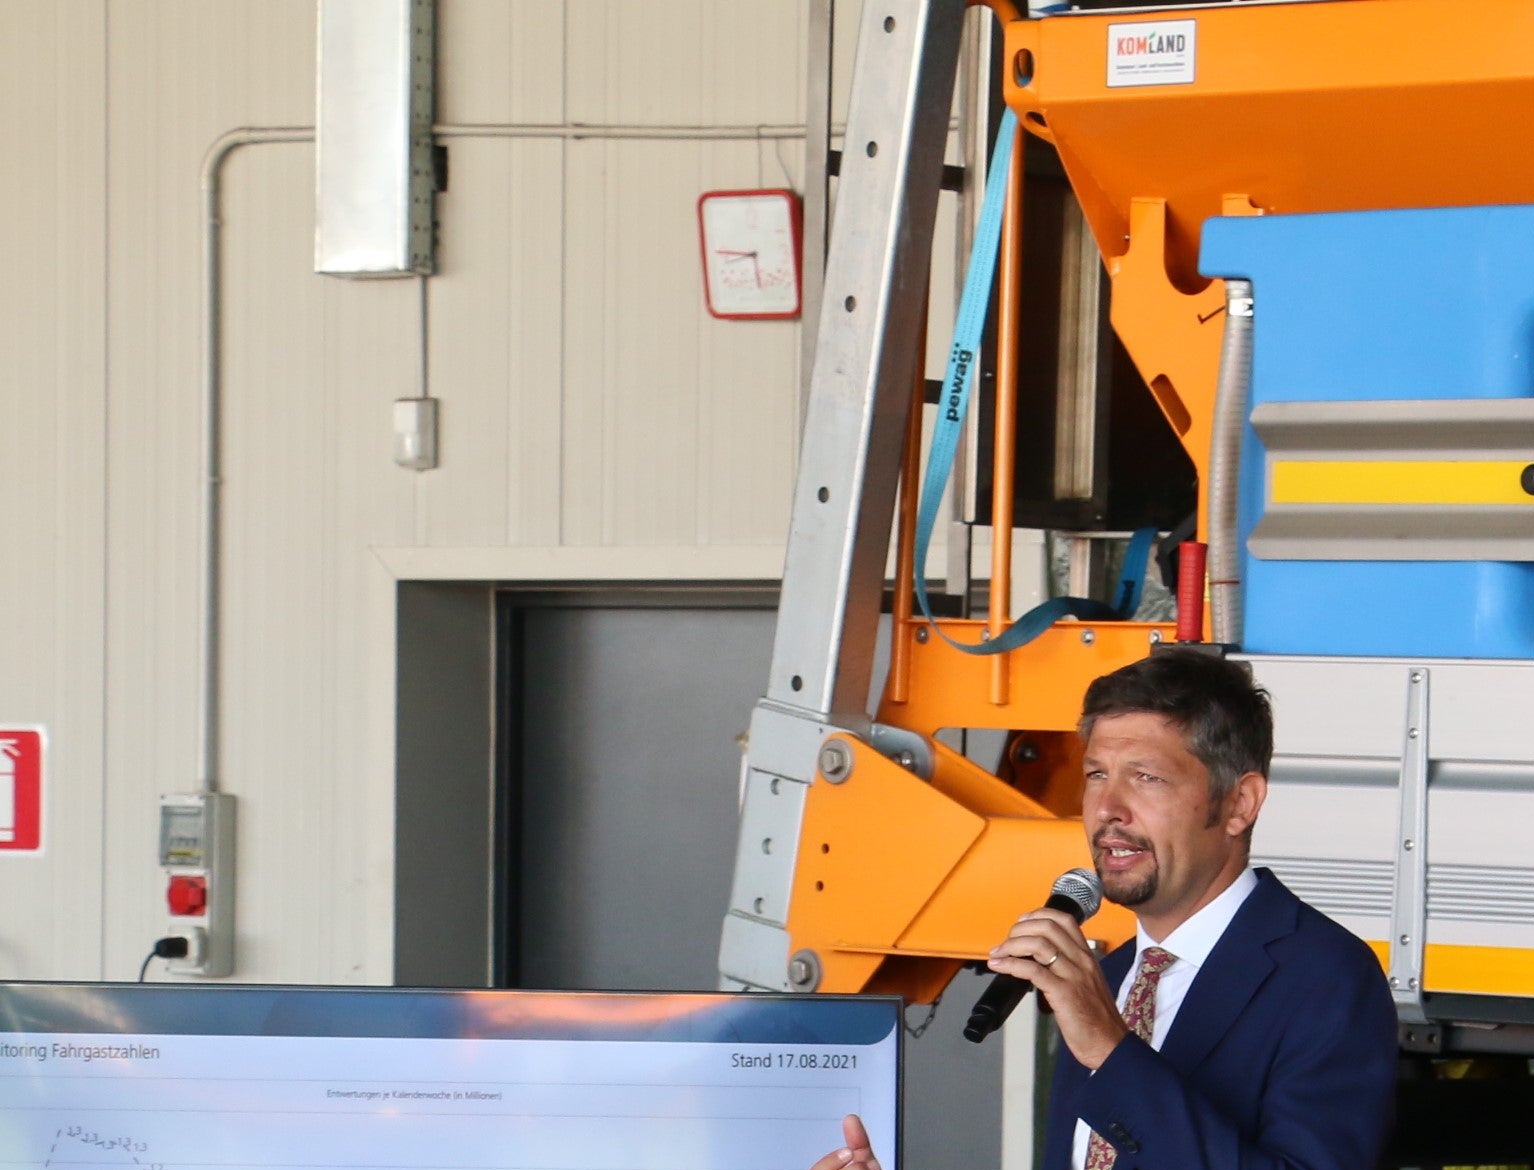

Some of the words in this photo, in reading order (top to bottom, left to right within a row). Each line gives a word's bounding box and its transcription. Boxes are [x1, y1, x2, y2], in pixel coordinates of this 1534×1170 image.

[1117, 31, 1185, 55] KOMLAND
[946, 348, 973, 422] pewag
[52, 1043, 160, 1062] Fahrgastzahlen
[731, 1053, 772, 1068] Stand
[778, 1054, 857, 1069] 17.08.2021
